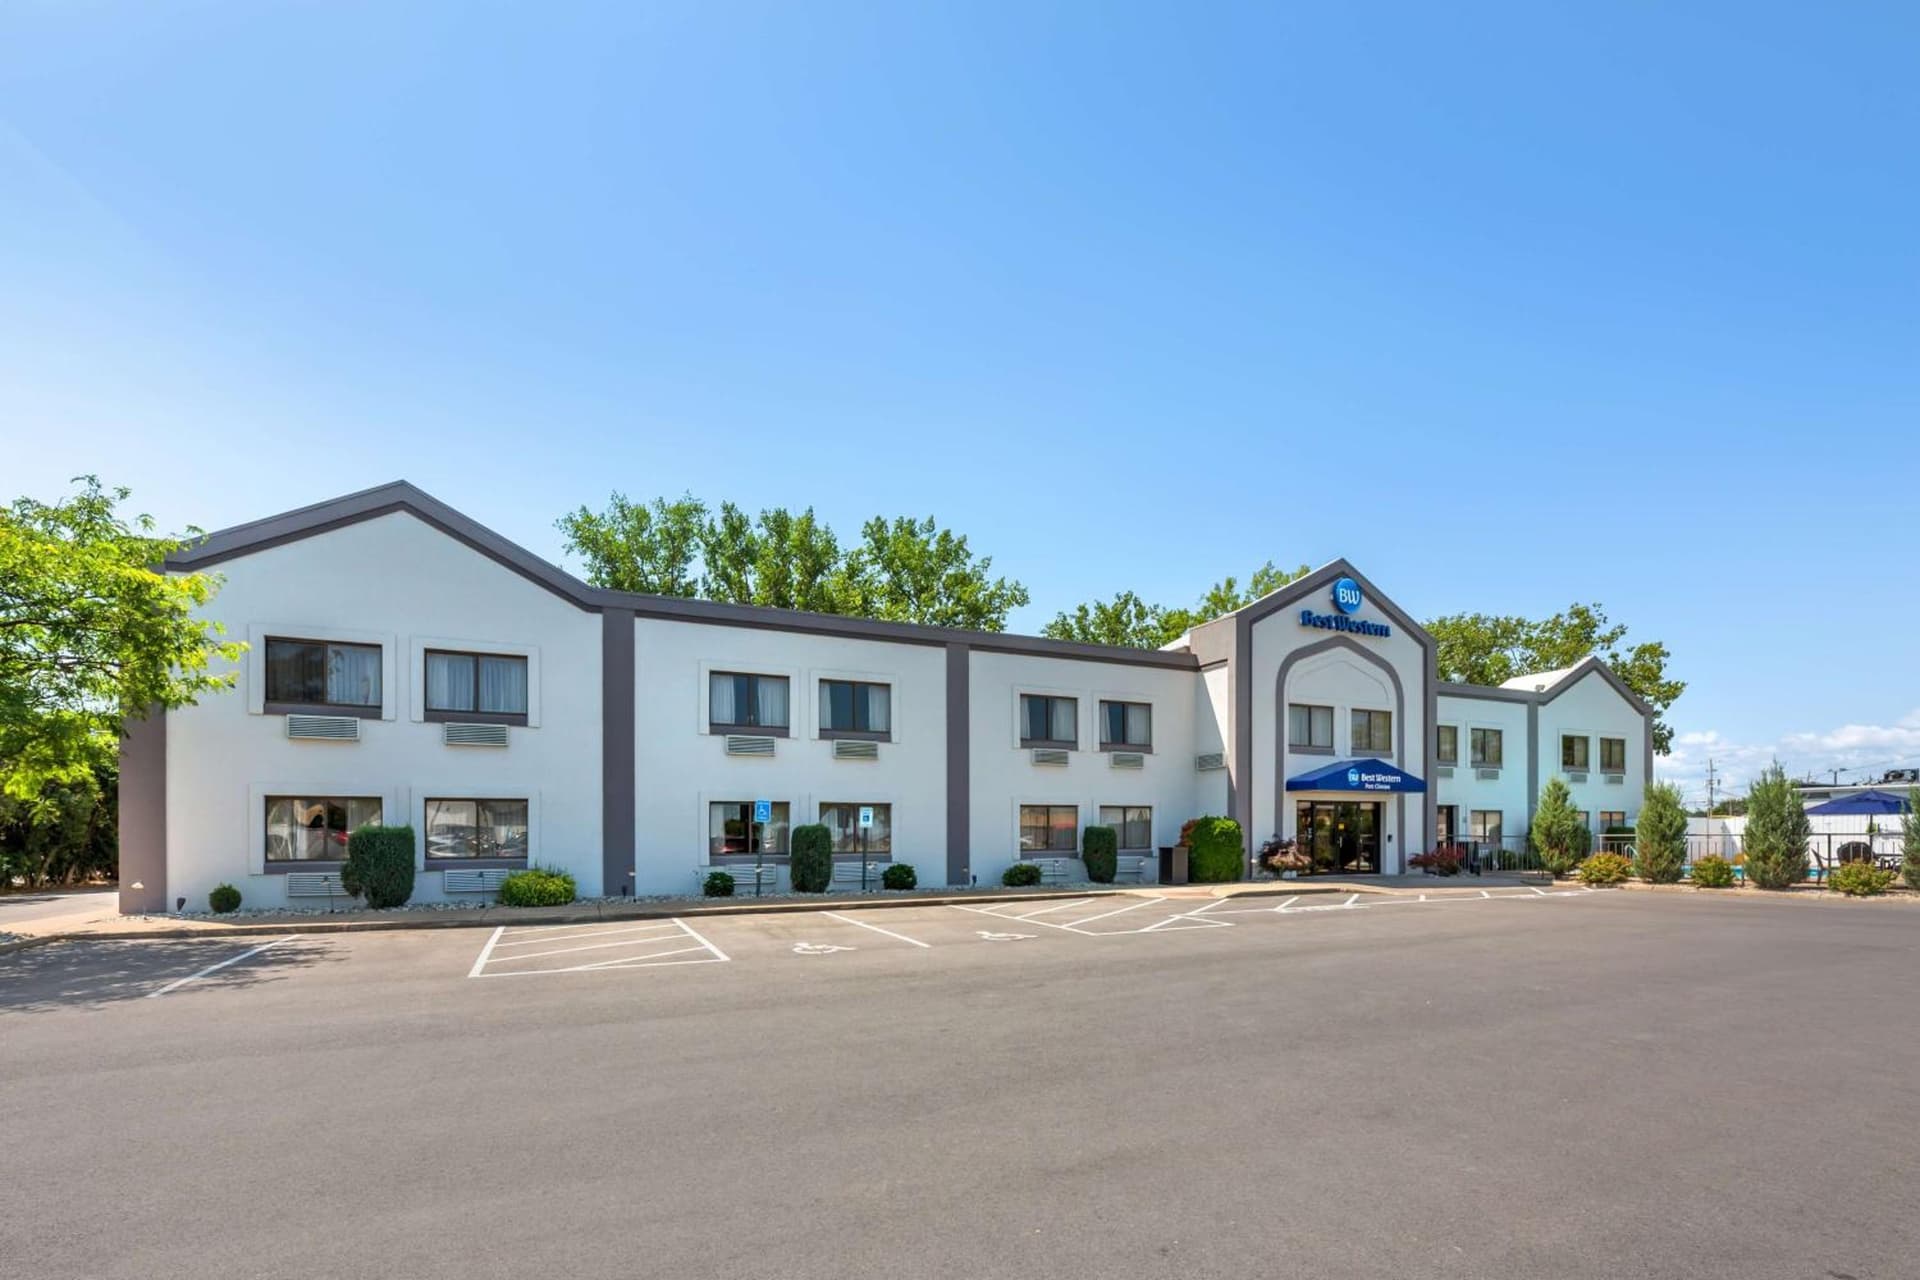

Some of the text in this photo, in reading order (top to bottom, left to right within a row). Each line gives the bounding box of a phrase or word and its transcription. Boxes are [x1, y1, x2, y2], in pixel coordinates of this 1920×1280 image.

[1339, 588, 1360, 605] BW
[1301, 609, 1391, 637] Best Western
[1361, 773, 1401, 783] Best Western
